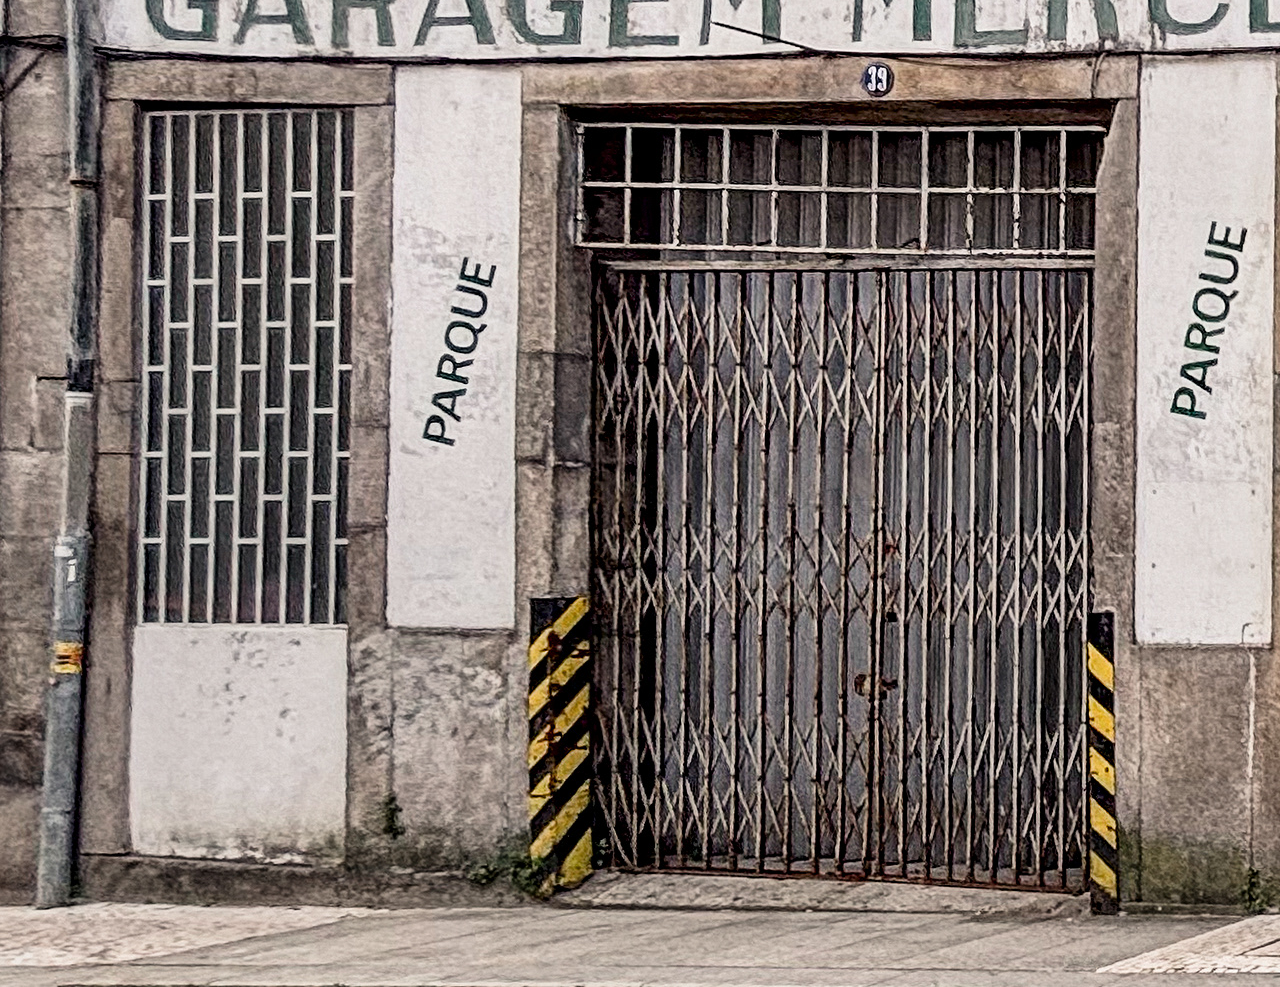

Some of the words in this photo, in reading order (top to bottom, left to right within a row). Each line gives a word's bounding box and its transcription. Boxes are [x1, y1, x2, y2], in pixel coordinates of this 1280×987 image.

[867, 66, 887, 91] 39
[423, 255, 497, 447] PARQUE
[1171, 220, 1248, 420] PARQUE
